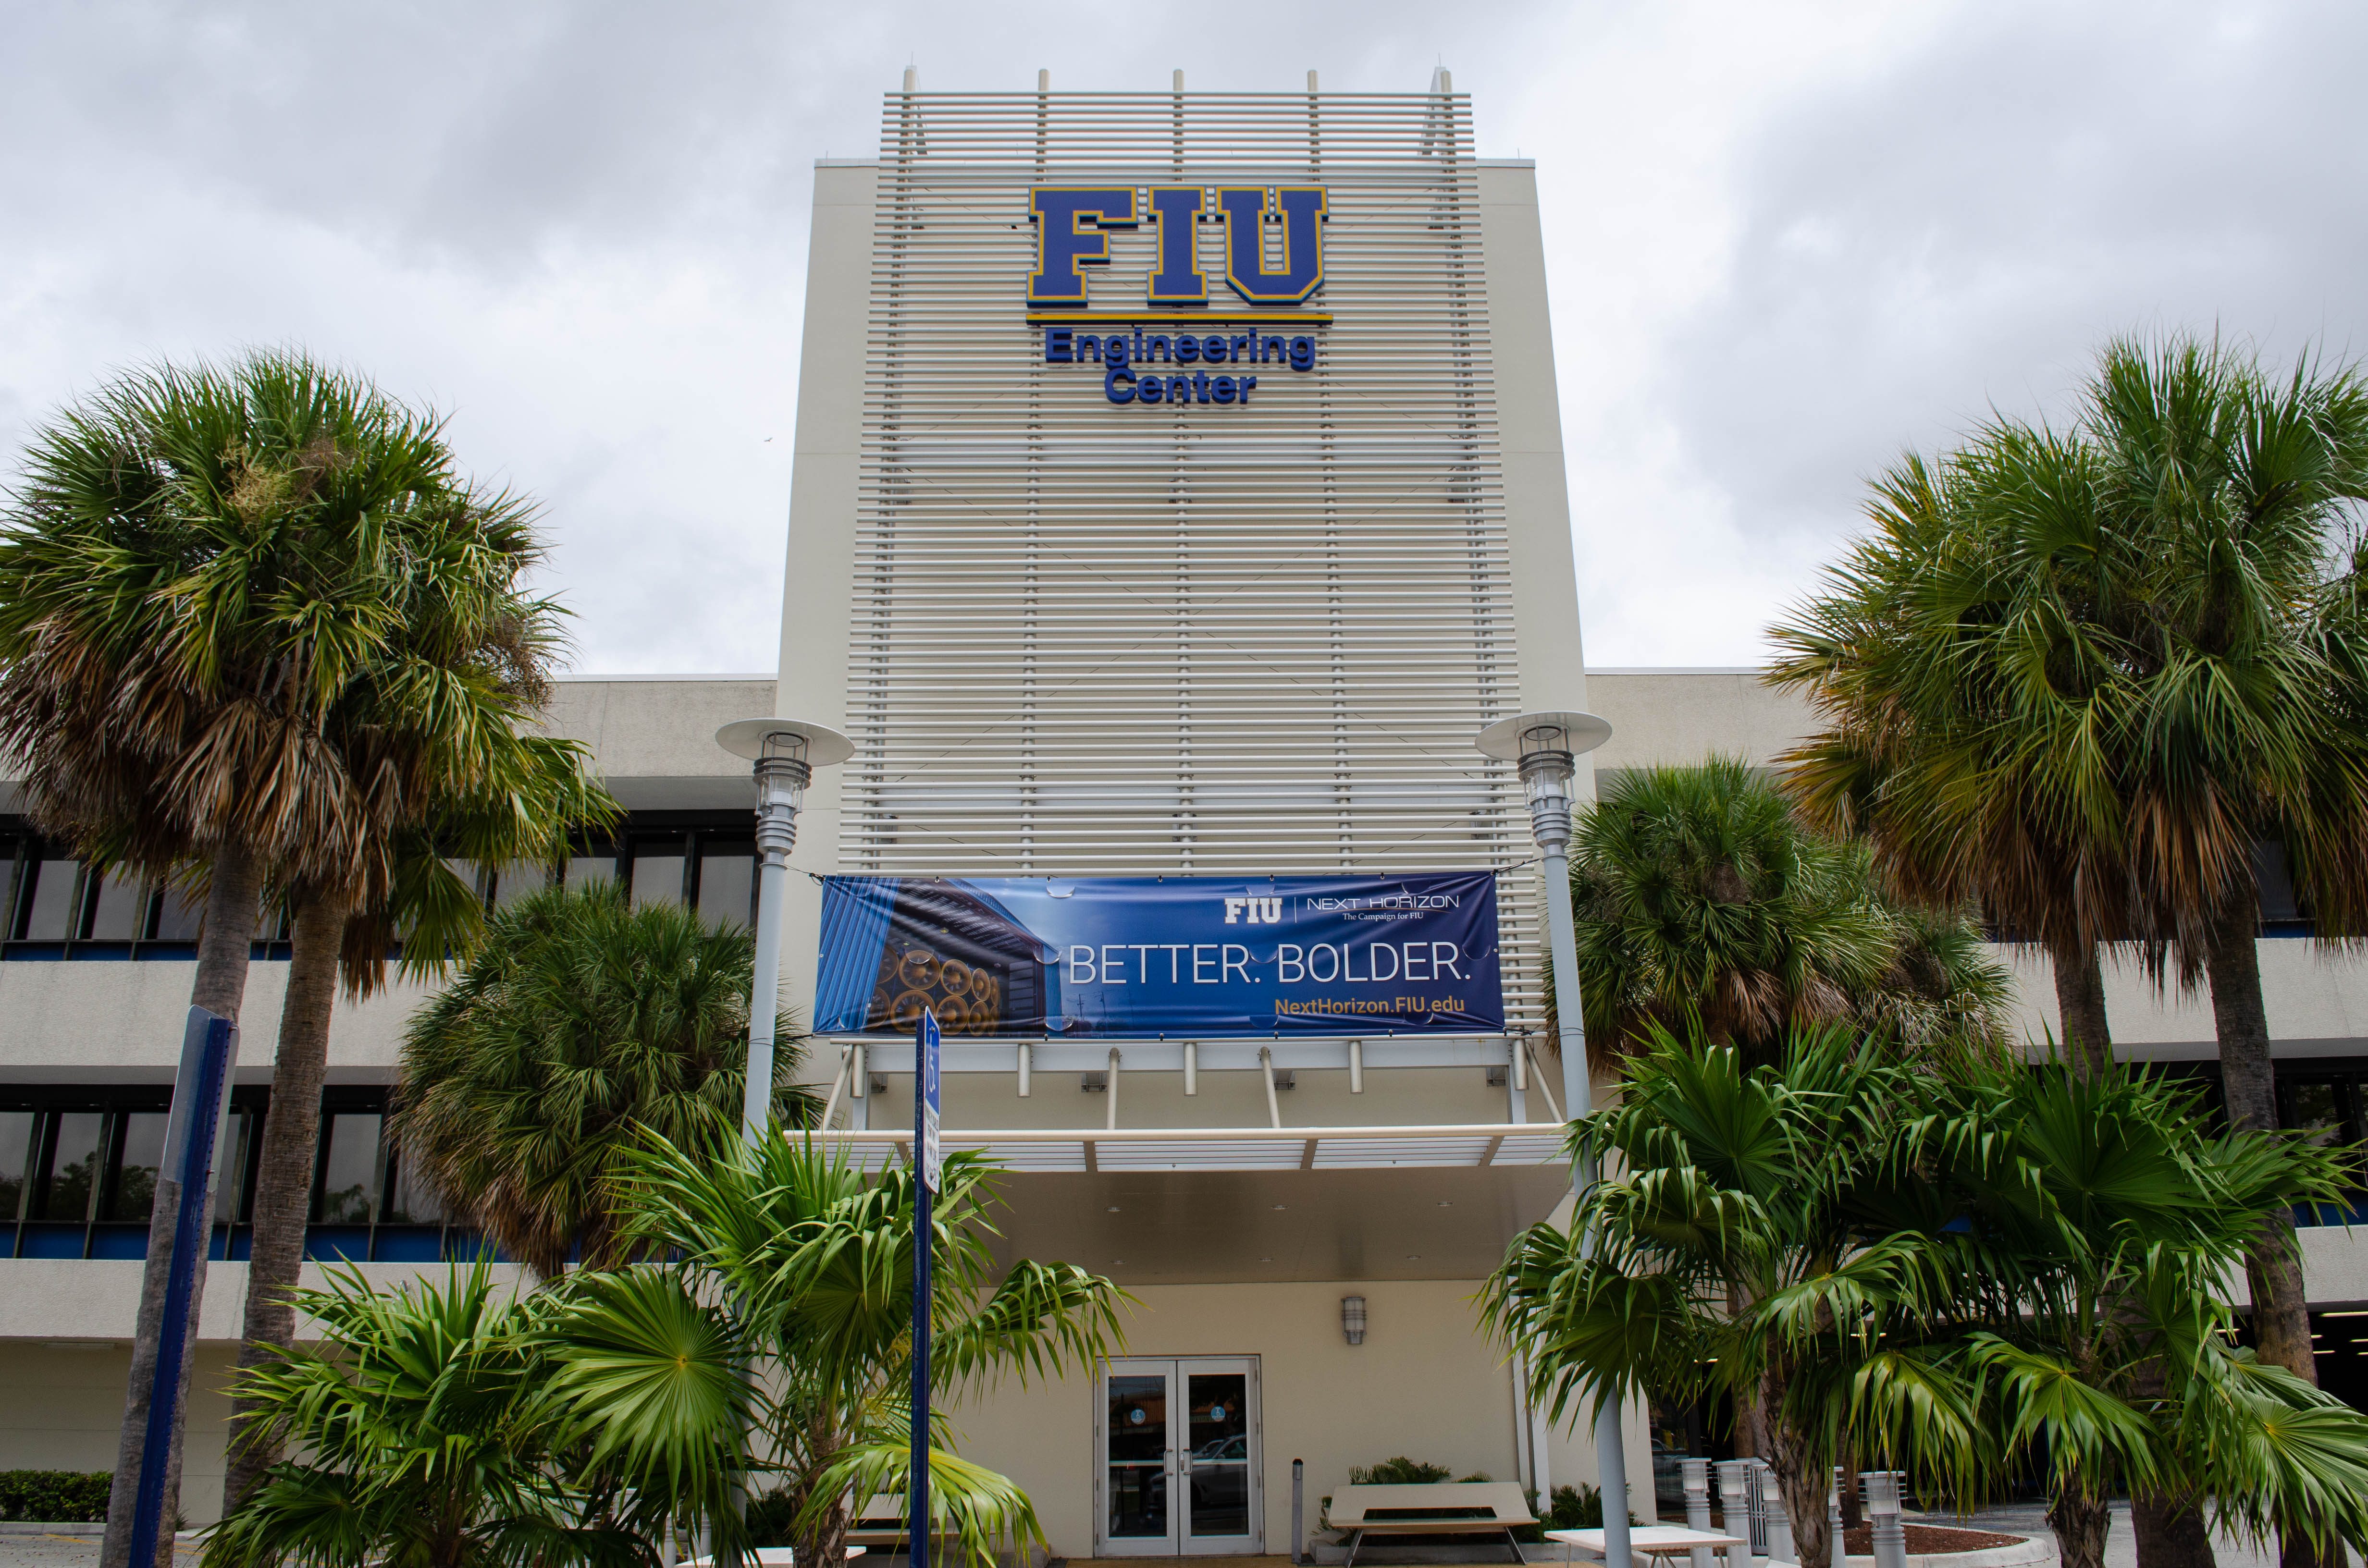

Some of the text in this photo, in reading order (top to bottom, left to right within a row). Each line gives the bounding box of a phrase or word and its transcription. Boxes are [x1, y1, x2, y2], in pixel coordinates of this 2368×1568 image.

[1026, 185, 1328, 308] FIU
[1045, 328, 1315, 372] Engineering
[1105, 368, 1257, 404] Center
[1224, 897, 1283, 924] FIU
[1307, 895, 1459, 910] NEXT HORIZON
[1358, 913, 1395, 922] Campaign
[1069, 942, 1471, 984] BETTER. BOLDER.
[1275, 995, 1465, 1015] NextHorizon.FIU.edu
